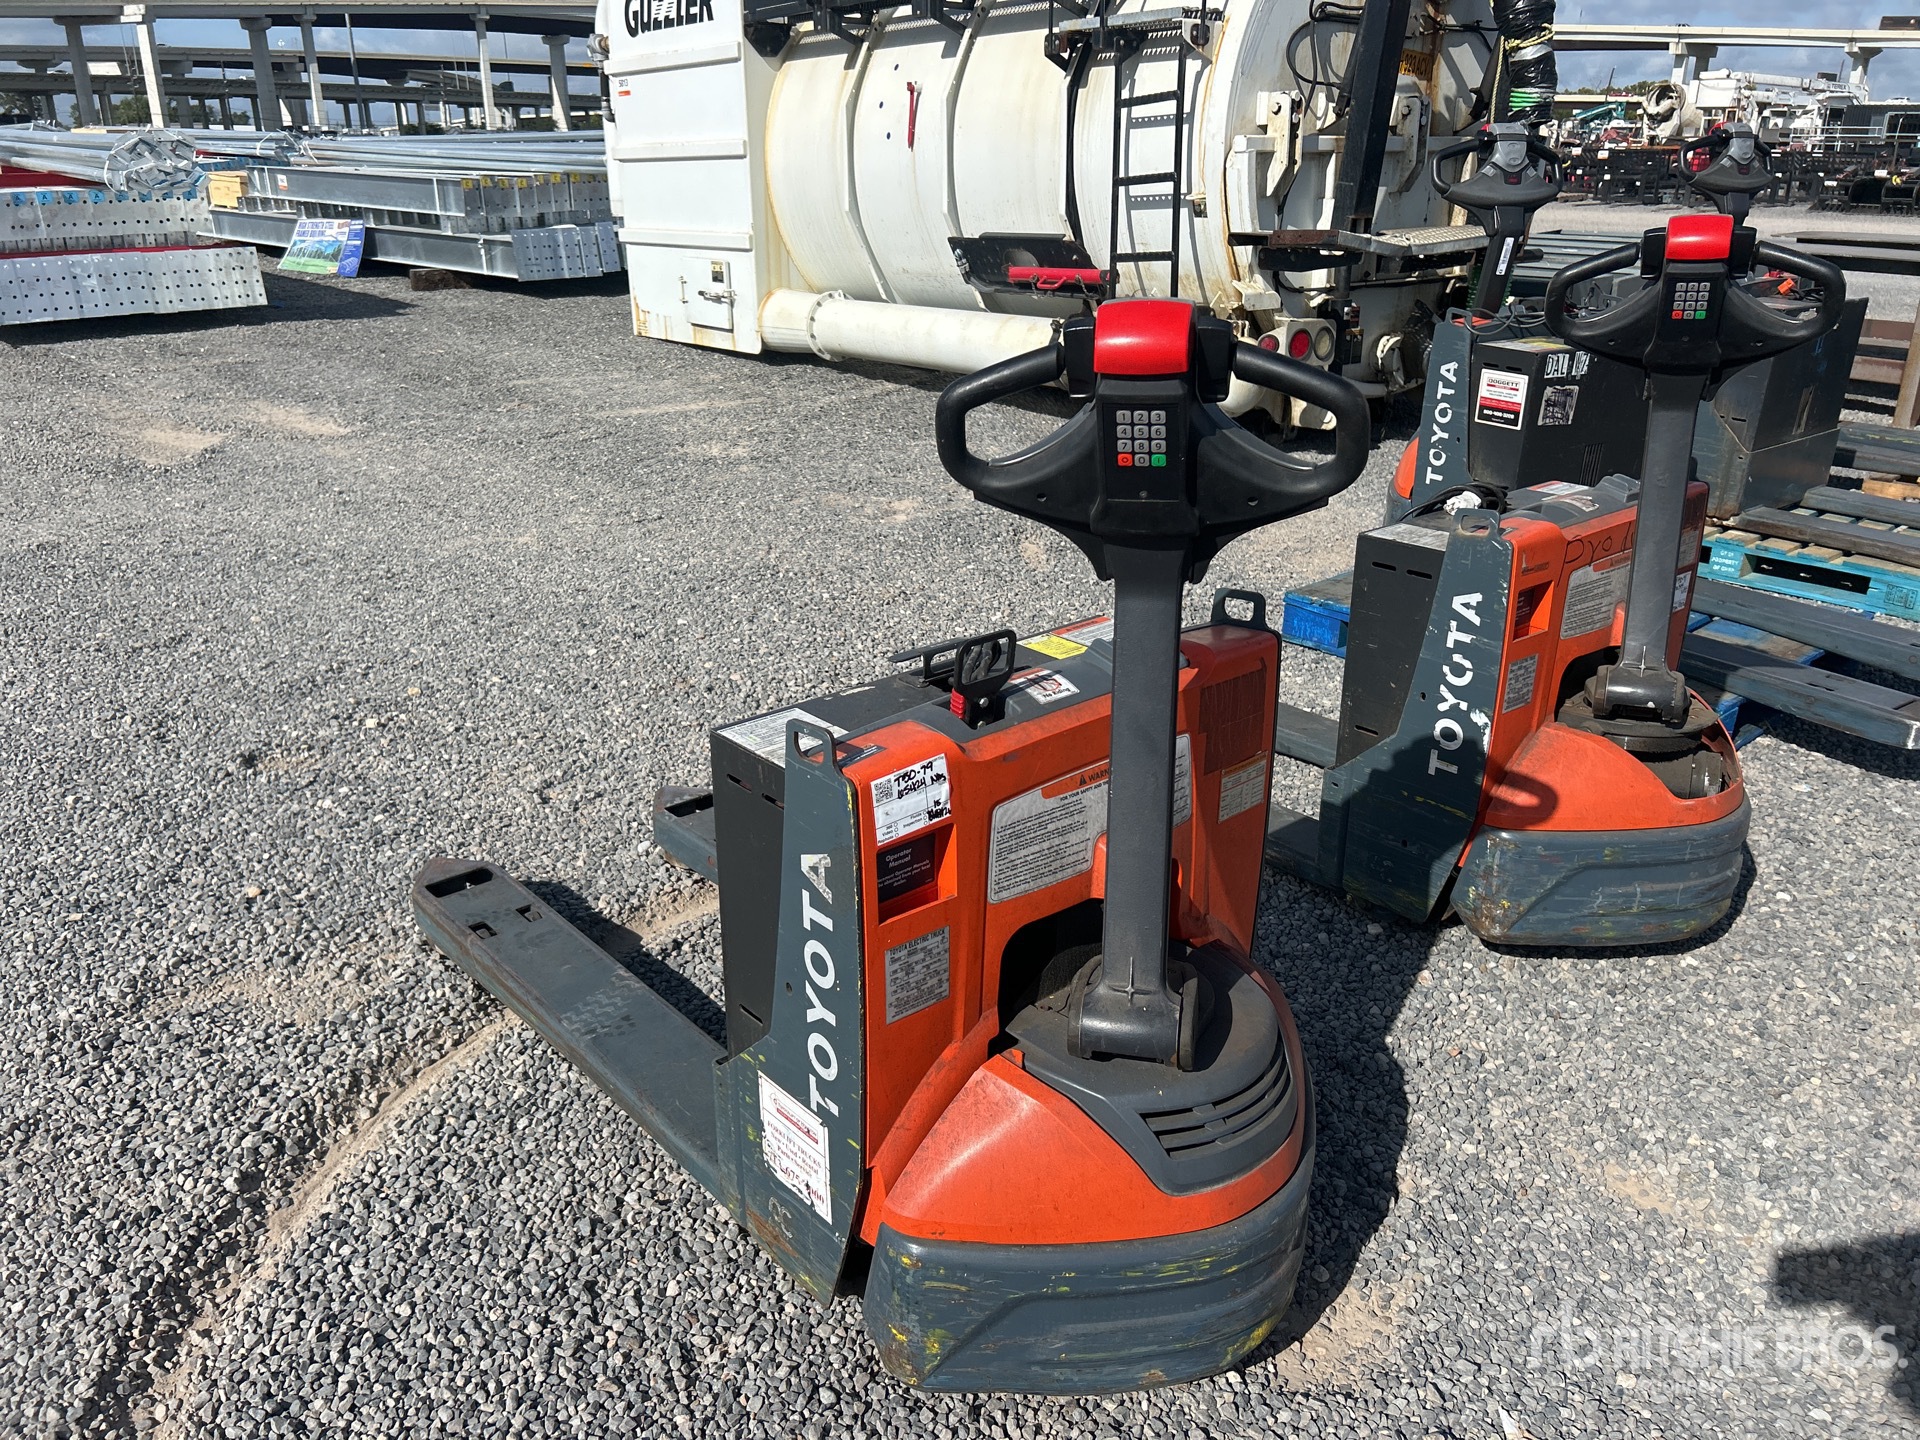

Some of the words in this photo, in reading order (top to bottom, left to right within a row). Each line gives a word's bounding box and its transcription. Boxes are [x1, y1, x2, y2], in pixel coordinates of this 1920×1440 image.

[1488, 377, 1519, 388] DOGGETT
[1137, 413, 1144, 421] 2
[1155, 413, 1161, 421] 3
[1425, 361, 1459, 485] TOYOTA
[1121, 428, 1127, 436] 4
[1138, 428, 1144, 436] 5
[1155, 428, 1161, 436] 6
[1121, 442, 1128, 450] 7
[1138, 442, 1145, 450] 8
[1155, 442, 1162, 450] 9
[1042, 691, 1053, 699] No
[1087, 767, 1110, 782] WARN
[1068, 791, 1080, 800] YOUR
[1080, 786, 1093, 795] SAFETY
[882, 829, 894, 837] Video
[885, 848, 912, 862] Operator
[888, 854, 911, 868] Manual
[889, 944, 908, 957] TOYOTA
[908, 935, 930, 949] ELECTRIC
[930, 928, 946, 939] TRUCK
[800, 853, 840, 1118] TOYOTA
[767, 1119, 797, 1148] FORKLIFT
[798, 1143, 822, 1169] TRUCKS
[785, 1142, 798, 1157] Used
[801, 1155, 819, 1175] Rental
